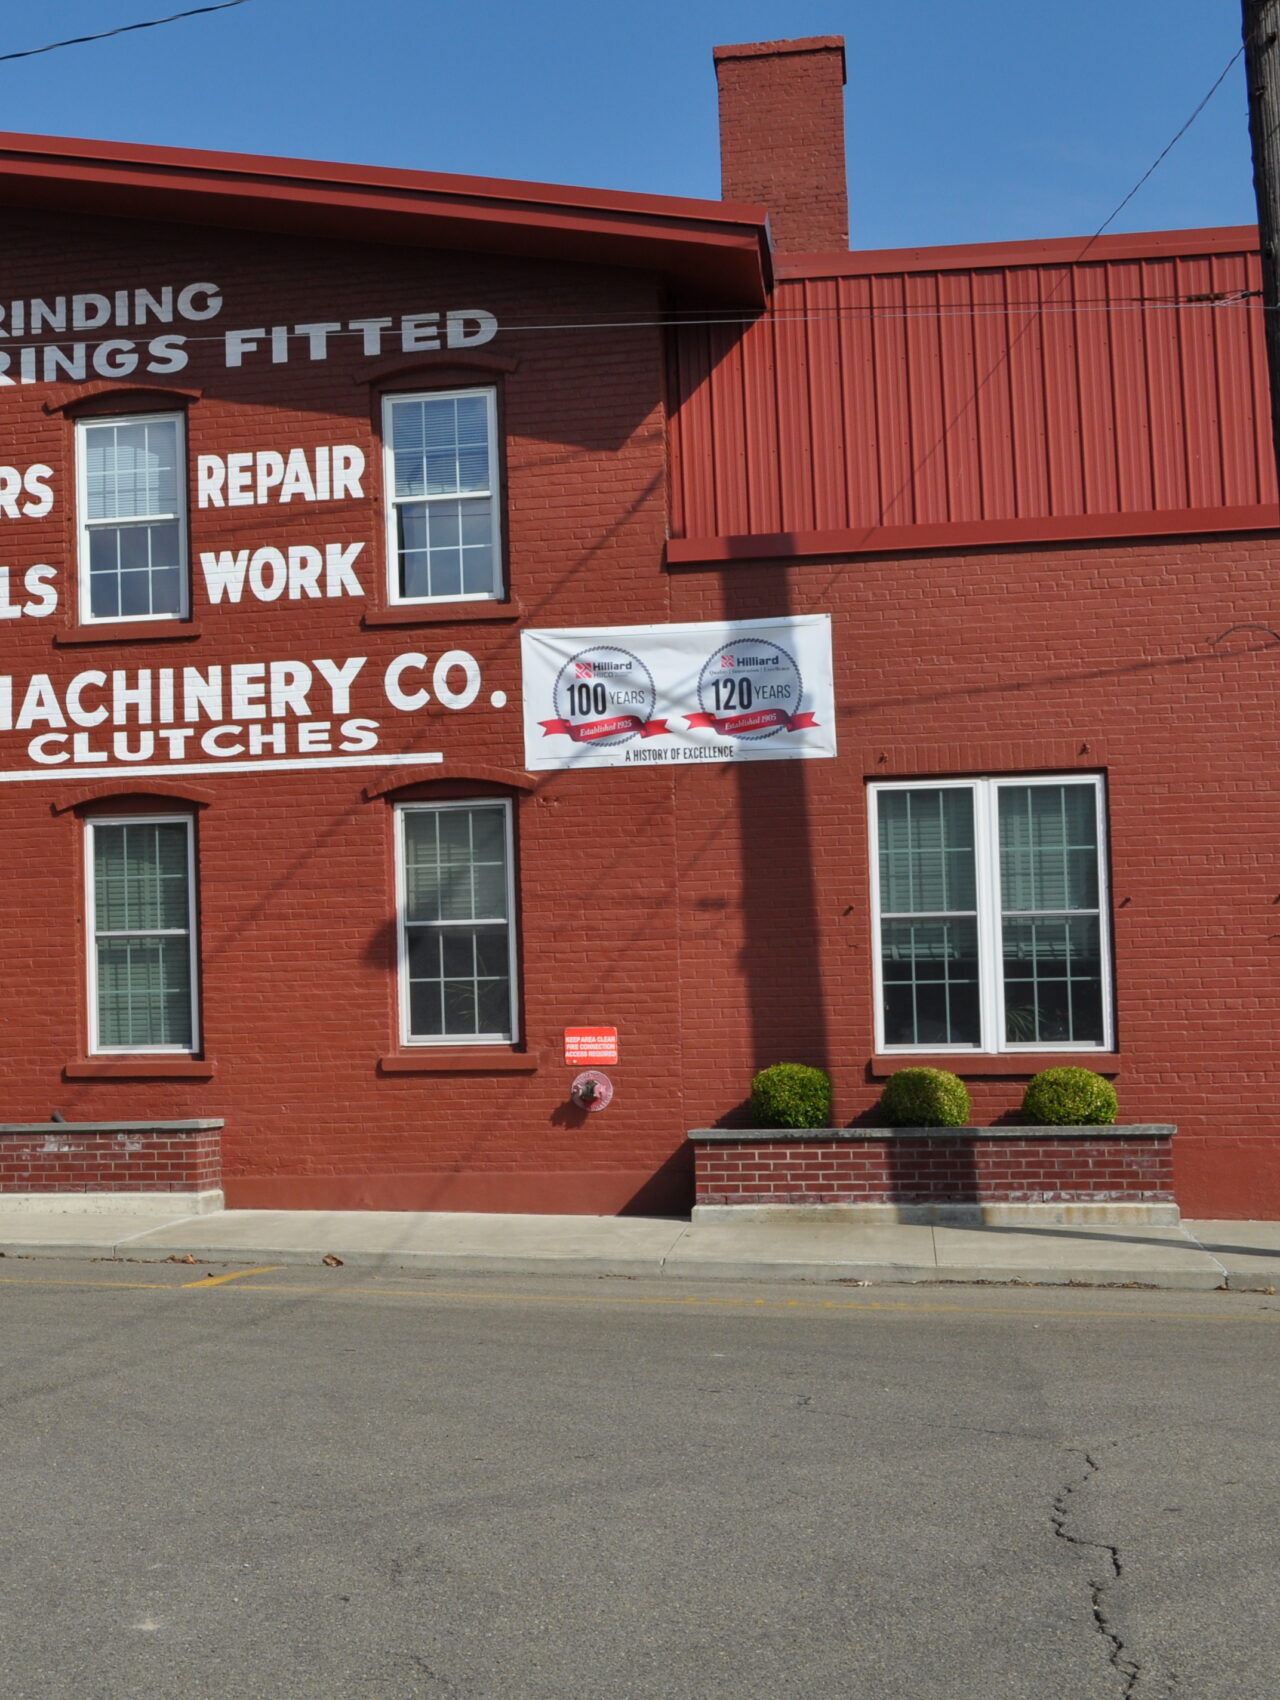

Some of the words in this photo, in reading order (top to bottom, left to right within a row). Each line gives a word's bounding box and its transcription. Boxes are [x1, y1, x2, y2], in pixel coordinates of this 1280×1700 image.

[225, 309, 499, 367] FITTED
[197, 445, 365, 509] REPAIR
[199, 542, 365, 604] WORK
[592, 661, 632, 671] Hilliard
[737, 655, 779, 666] Hilliard
[384, 650, 507, 714] CO.
[566, 682, 607, 716] 100
[609, 690, 645, 704] YEARS
[711, 677, 752, 711] 120
[754, 684, 791, 699] YEARS
[580, 722, 616, 736] Established
[724, 716, 760, 731] Established
[28, 718, 380, 764] CLUTCHES
[625, 750, 631, 761] A
[633, 749, 668, 761] HISTORY
[671, 748, 680, 760] OF
[683, 745, 734, 759] EXCELLENCE
